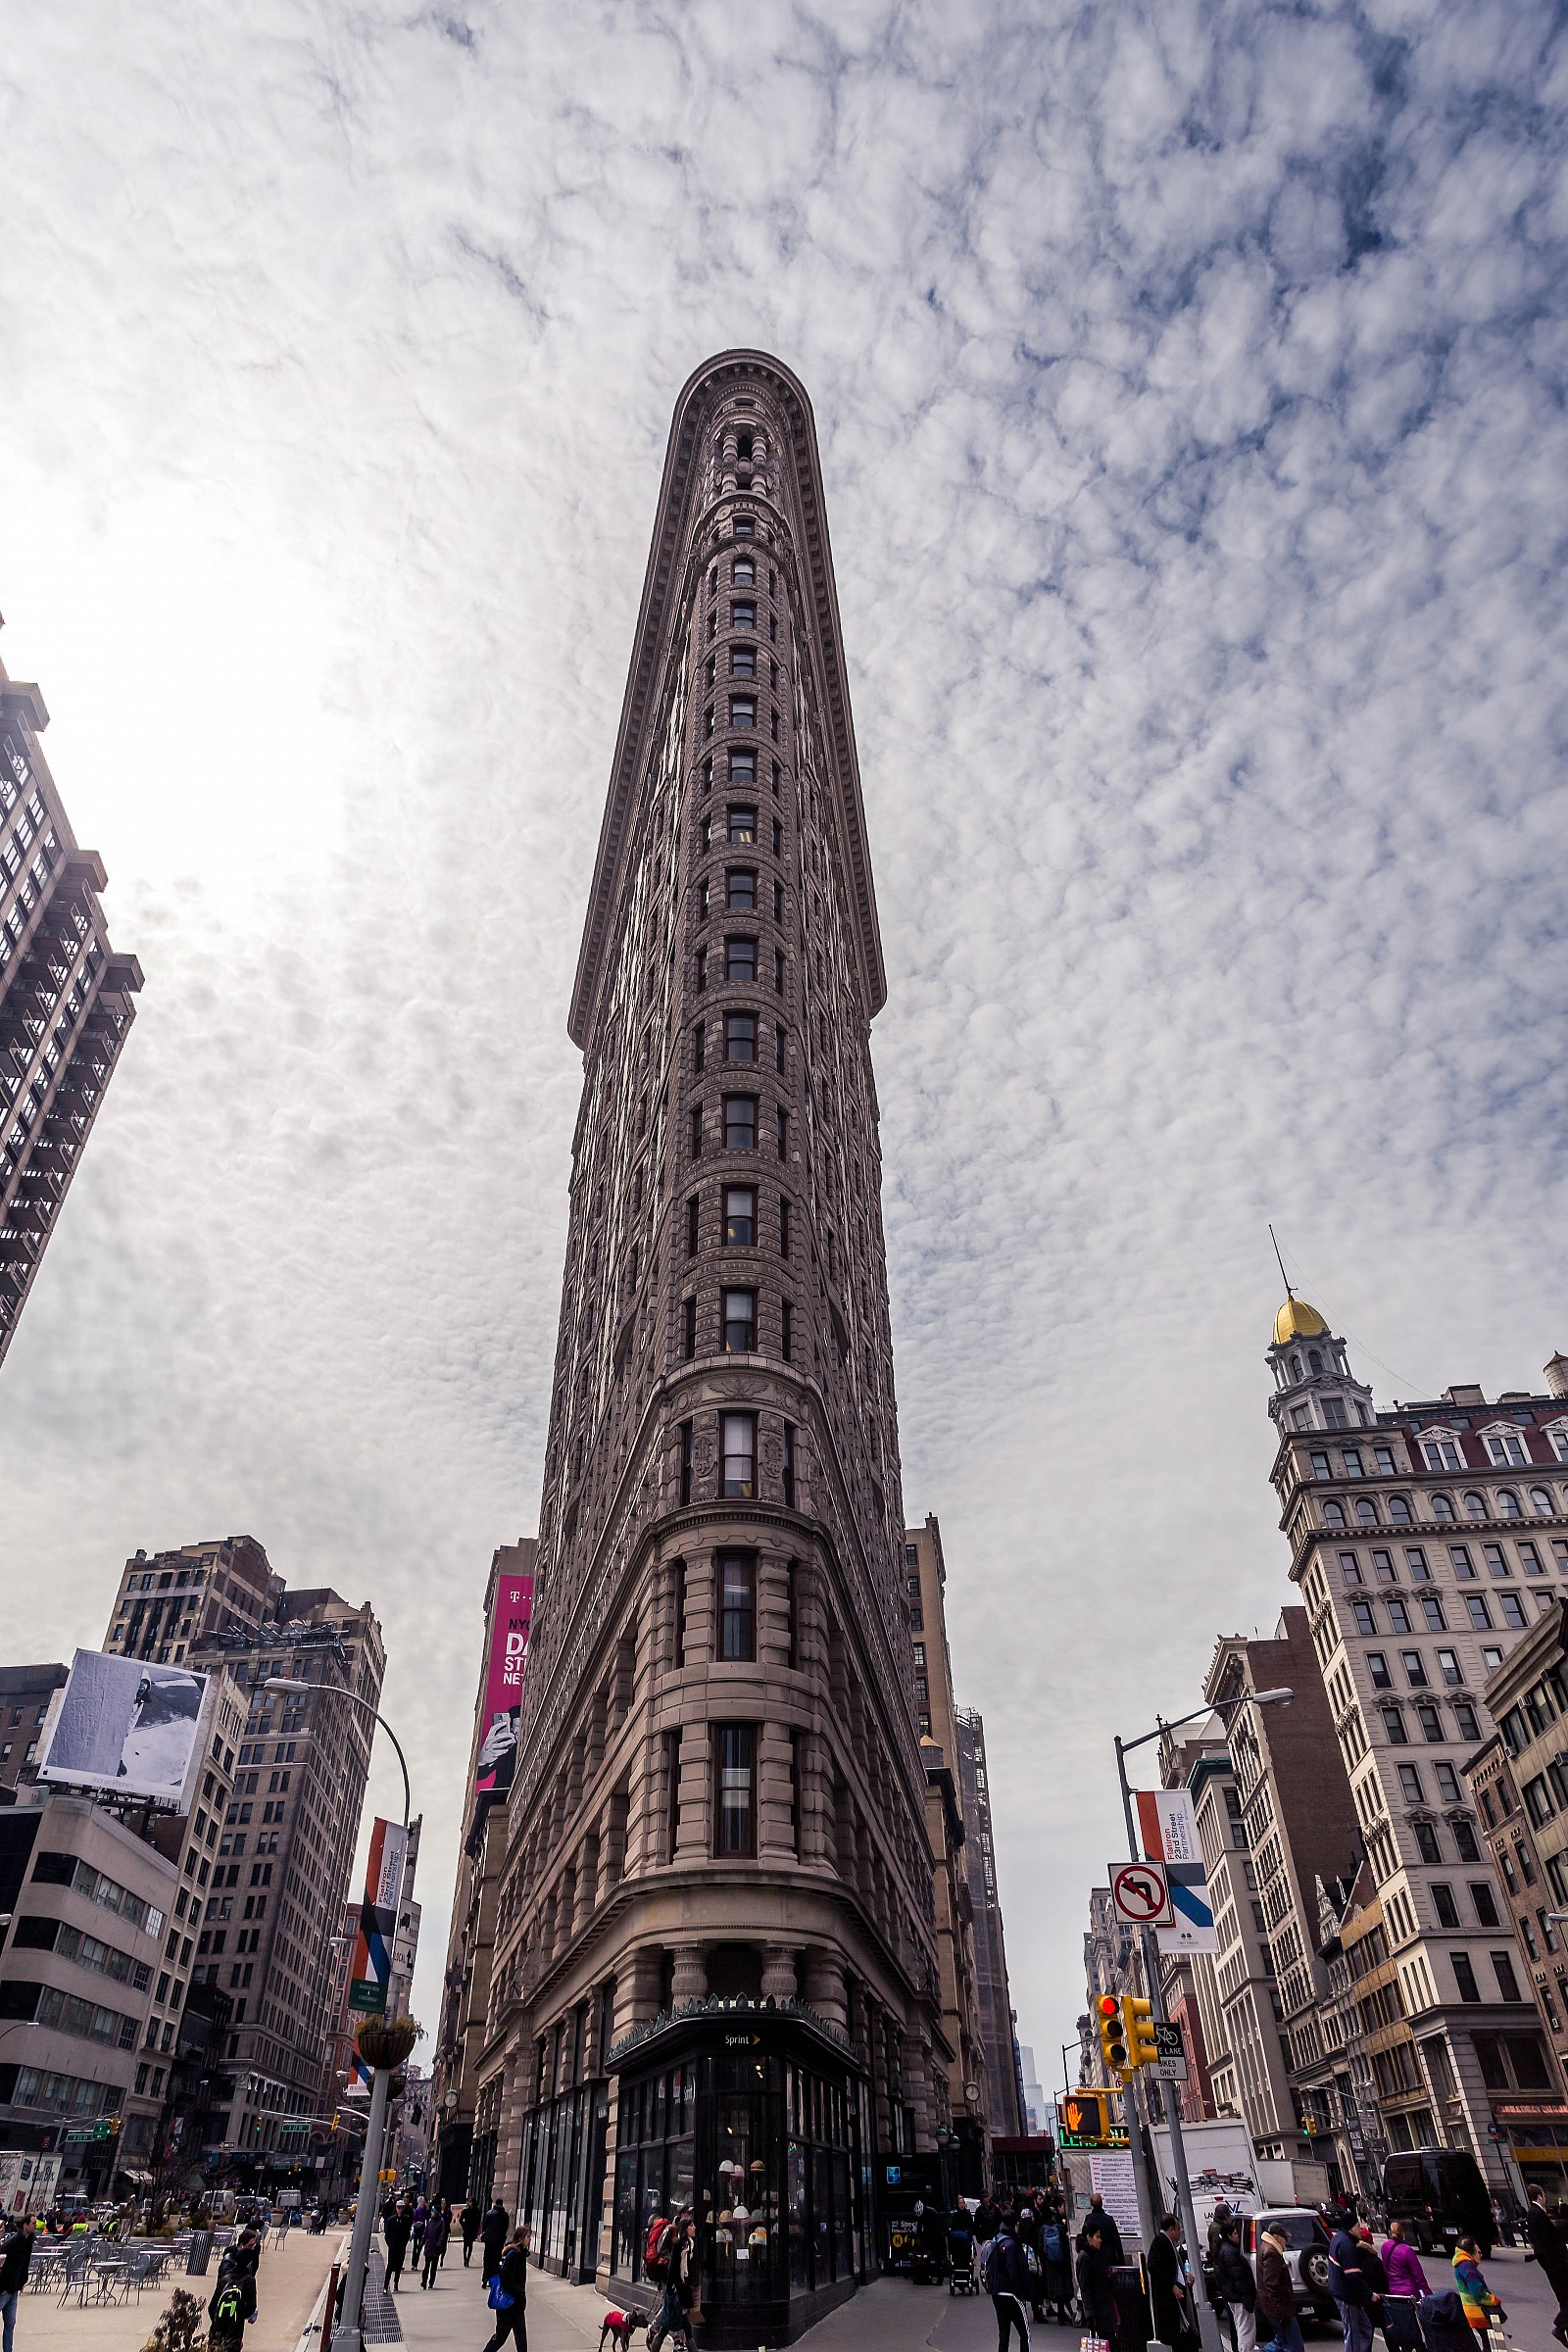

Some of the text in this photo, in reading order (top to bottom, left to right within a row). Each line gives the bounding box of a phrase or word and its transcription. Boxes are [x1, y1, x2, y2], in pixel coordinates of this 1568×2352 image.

[504, 1656, 527, 1672] ST
[1165, 1828, 1174, 1860] Flatiron
[1169, 1813, 1182, 1860] 23rd Street
[1177, 1813, 1189, 1860] Partnership
[379, 1866, 388, 1902] Flatiron
[386, 1852, 399, 1905] Partnership
[725, 2034, 750, 2046] Sprint
[1159, 2068, 1177, 2077] ONLY
